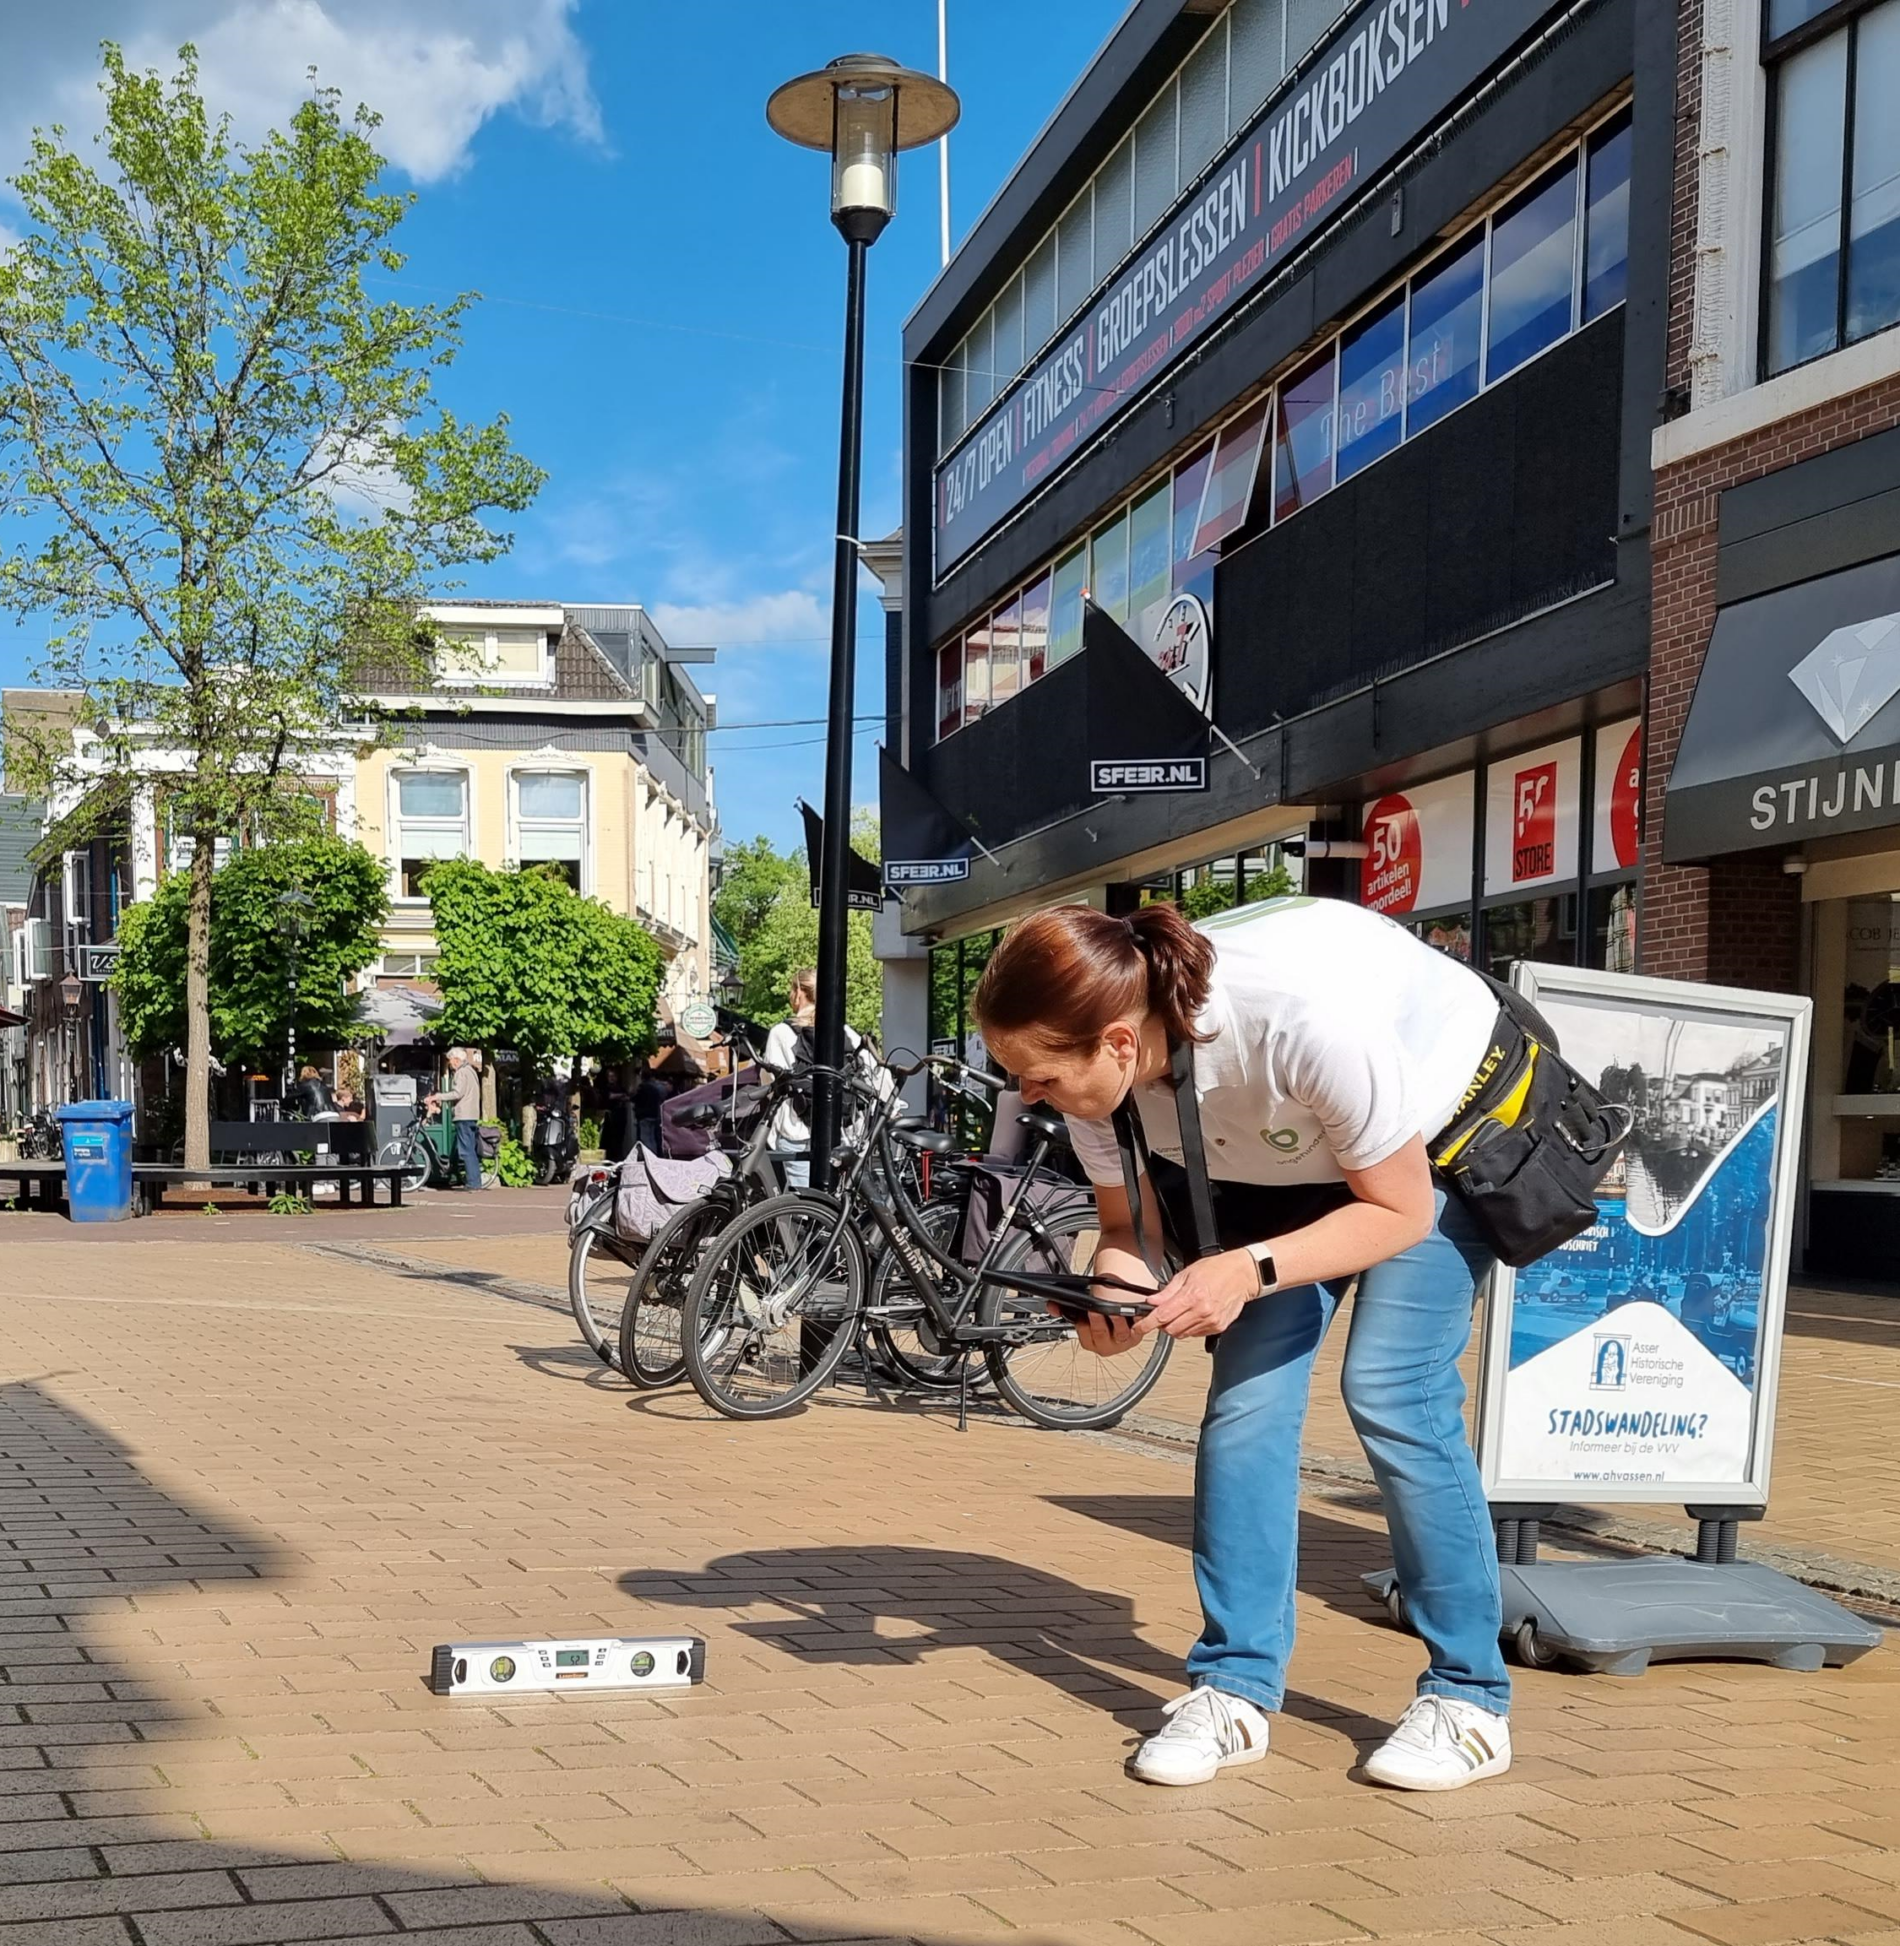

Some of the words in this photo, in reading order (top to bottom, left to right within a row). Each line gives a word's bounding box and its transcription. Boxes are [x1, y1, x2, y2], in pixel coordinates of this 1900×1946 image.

[1270, 202, 1302, 254] GRATIS
[1303, 153, 1353, 222] PARKEREN
[945, 447, 977, 525] 24/7
[979, 409, 1014, 492] OPEN
[1023, 334, 1085, 448] FITNESS
[1097, 158, 1247, 374] GROEPSLESSEN
[1320, 402, 1367, 458] The
[1373, 819, 1402, 871] 50
[1515, 842, 1552, 878] STORE
[1367, 862, 1410, 896] artikelen
[891, 1225, 922, 1274] CORTINA
[1630, 1357, 1684, 1371] Historische
[1632, 1342, 1660, 1354] Asser
[1629, 1373, 1684, 1388] Vereniging
[1548, 1408, 1709, 1440] STADSWANDELING?
[1569, 1440, 1622, 1454] Informeer
[1624, 1441, 1639, 1456] bij
[1639, 1442, 1654, 1454] de
[1657, 1443, 1680, 1454] VVV
[1573, 1470, 1665, 1483] www.ahvassen.nl
